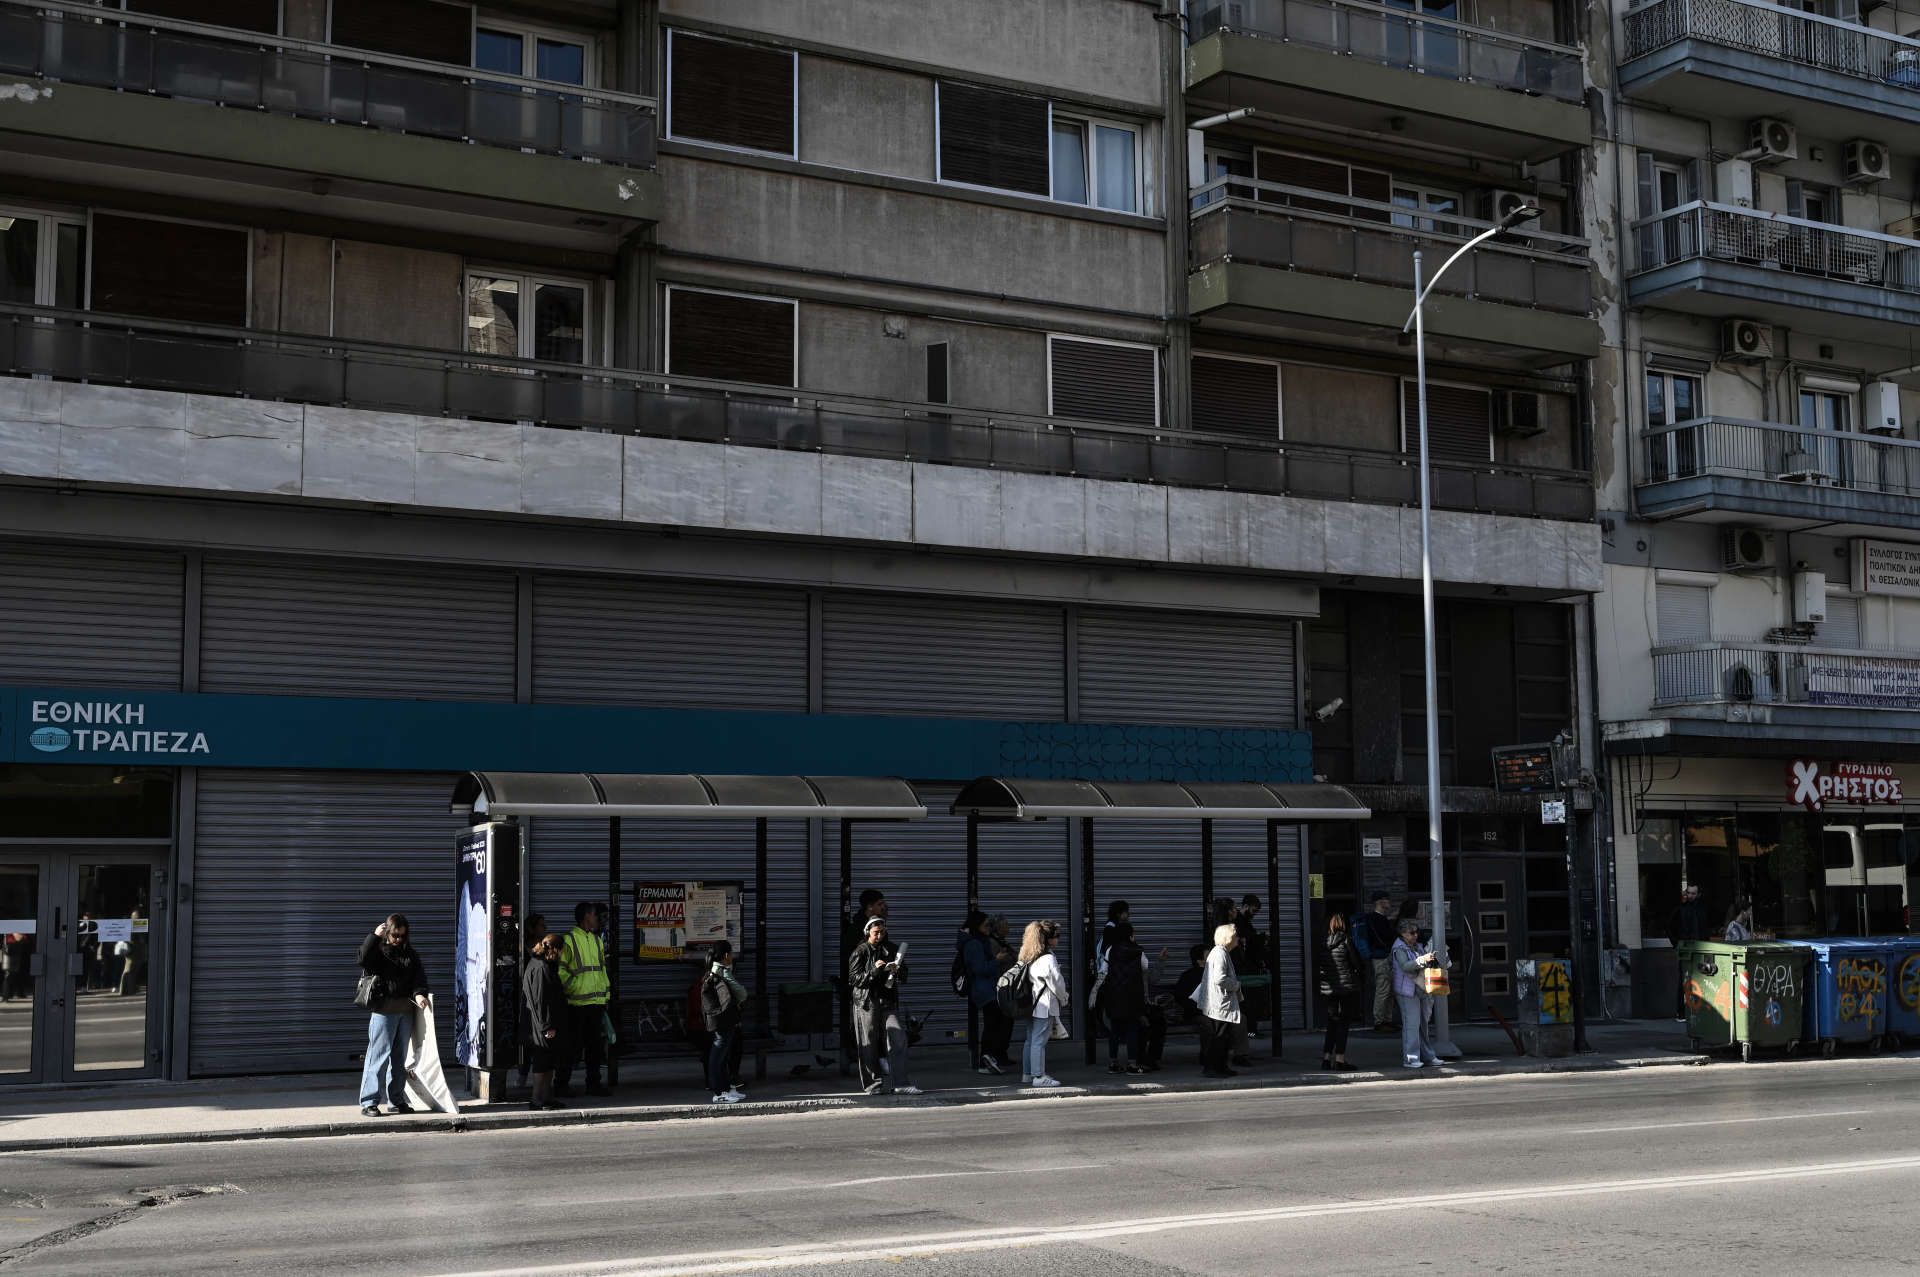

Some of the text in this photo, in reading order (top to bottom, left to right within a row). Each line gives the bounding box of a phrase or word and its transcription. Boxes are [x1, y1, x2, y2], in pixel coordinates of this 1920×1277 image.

[1869, 547, 1903, 560] ΣΥΛΛΟΓΟΣ
[1869, 560, 1906, 573] ΠΟΛΙΤΙΚΩΝ
[31, 700, 145, 725] ΕΘΝΙΚΗ
[73, 729, 210, 753] ΤΡΑΠΕΖΑ
[1838, 763, 1893, 776] ΓΥΡΑΔΙΚΟ
[1793, 760, 1903, 804] ΧΡΗΣΤΟΣ
[1483, 831, 1497, 841] 152
[638, 887, 685, 899] ΓΕΡΜΑΝΙΚΑ
[648, 902, 685, 918] ΑΛΜΑ
[1753, 963, 1795, 997] ΘΥΡΑ
